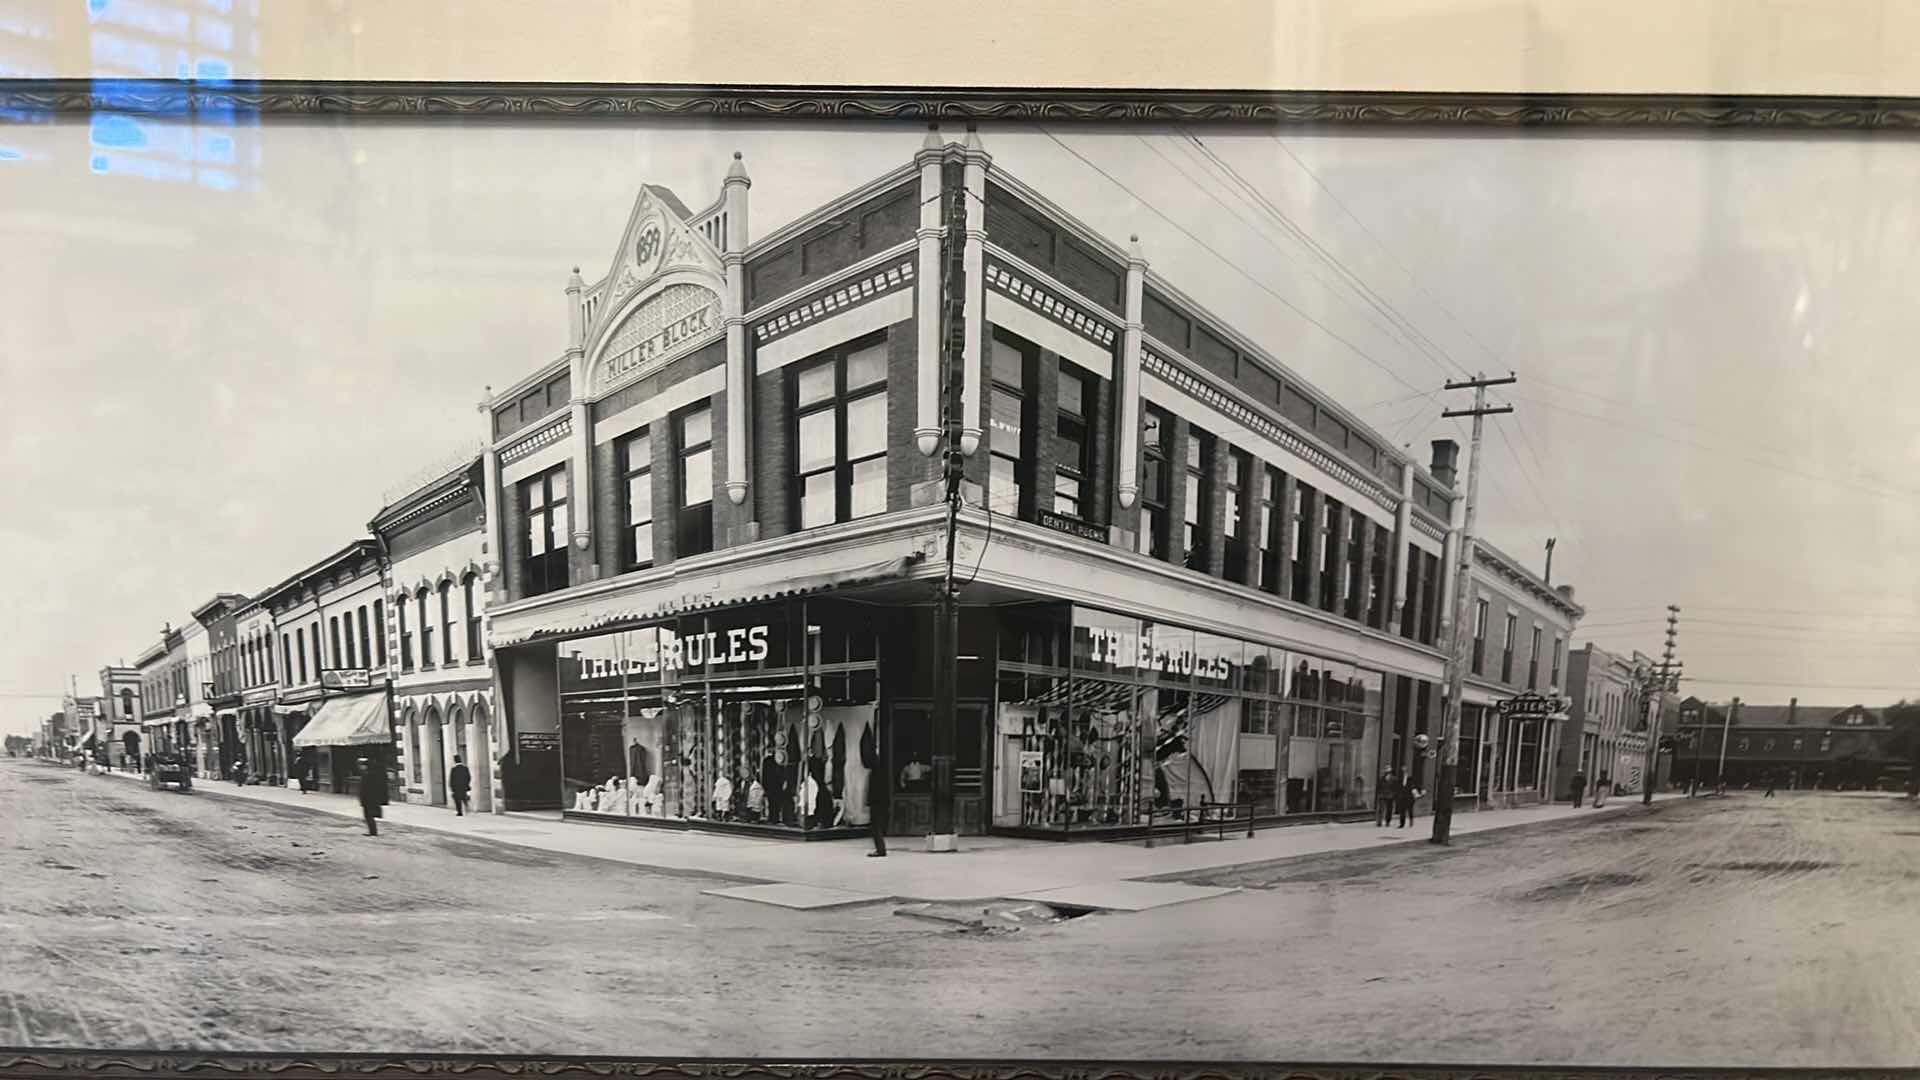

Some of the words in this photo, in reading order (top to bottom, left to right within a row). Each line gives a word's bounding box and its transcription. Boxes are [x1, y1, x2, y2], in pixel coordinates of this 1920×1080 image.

[608, 338, 656, 379] MILLER
[663, 307, 708, 348] BLOCK
[1043, 515, 1078, 535] DENTAL
[664, 625, 769, 672] RULES
